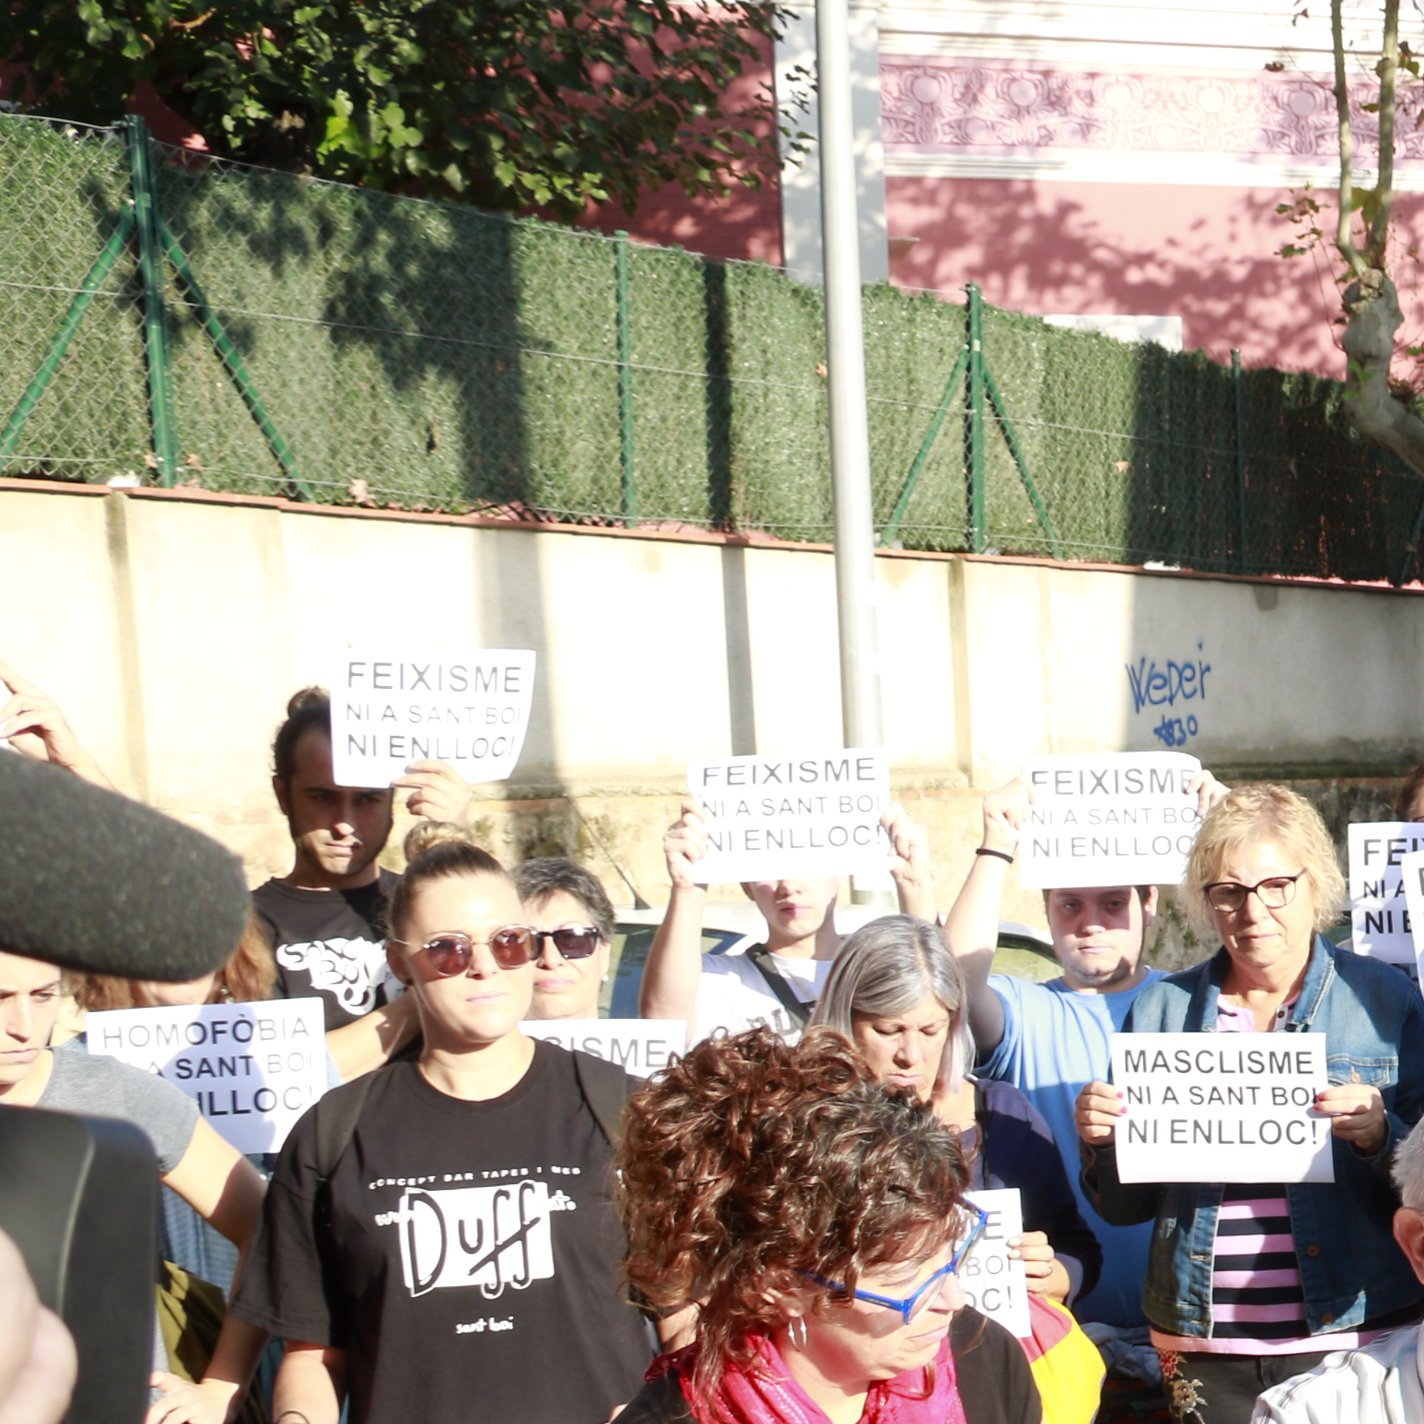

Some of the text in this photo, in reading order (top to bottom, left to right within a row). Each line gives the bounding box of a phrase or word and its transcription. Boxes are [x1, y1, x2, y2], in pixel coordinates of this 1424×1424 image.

[348, 662, 521, 692] FEIXISME
[348, 734, 514, 760] NI ENLLOC!
[703, 758, 875, 787] FEIXISME
[1125, 1050, 1314, 1074] MASCLISME
[1127, 1086, 1261, 1105] NI A SANT
[1129, 1119, 1316, 1145] NI ENLLOC!
[404, 1182, 541, 1300] Duff
